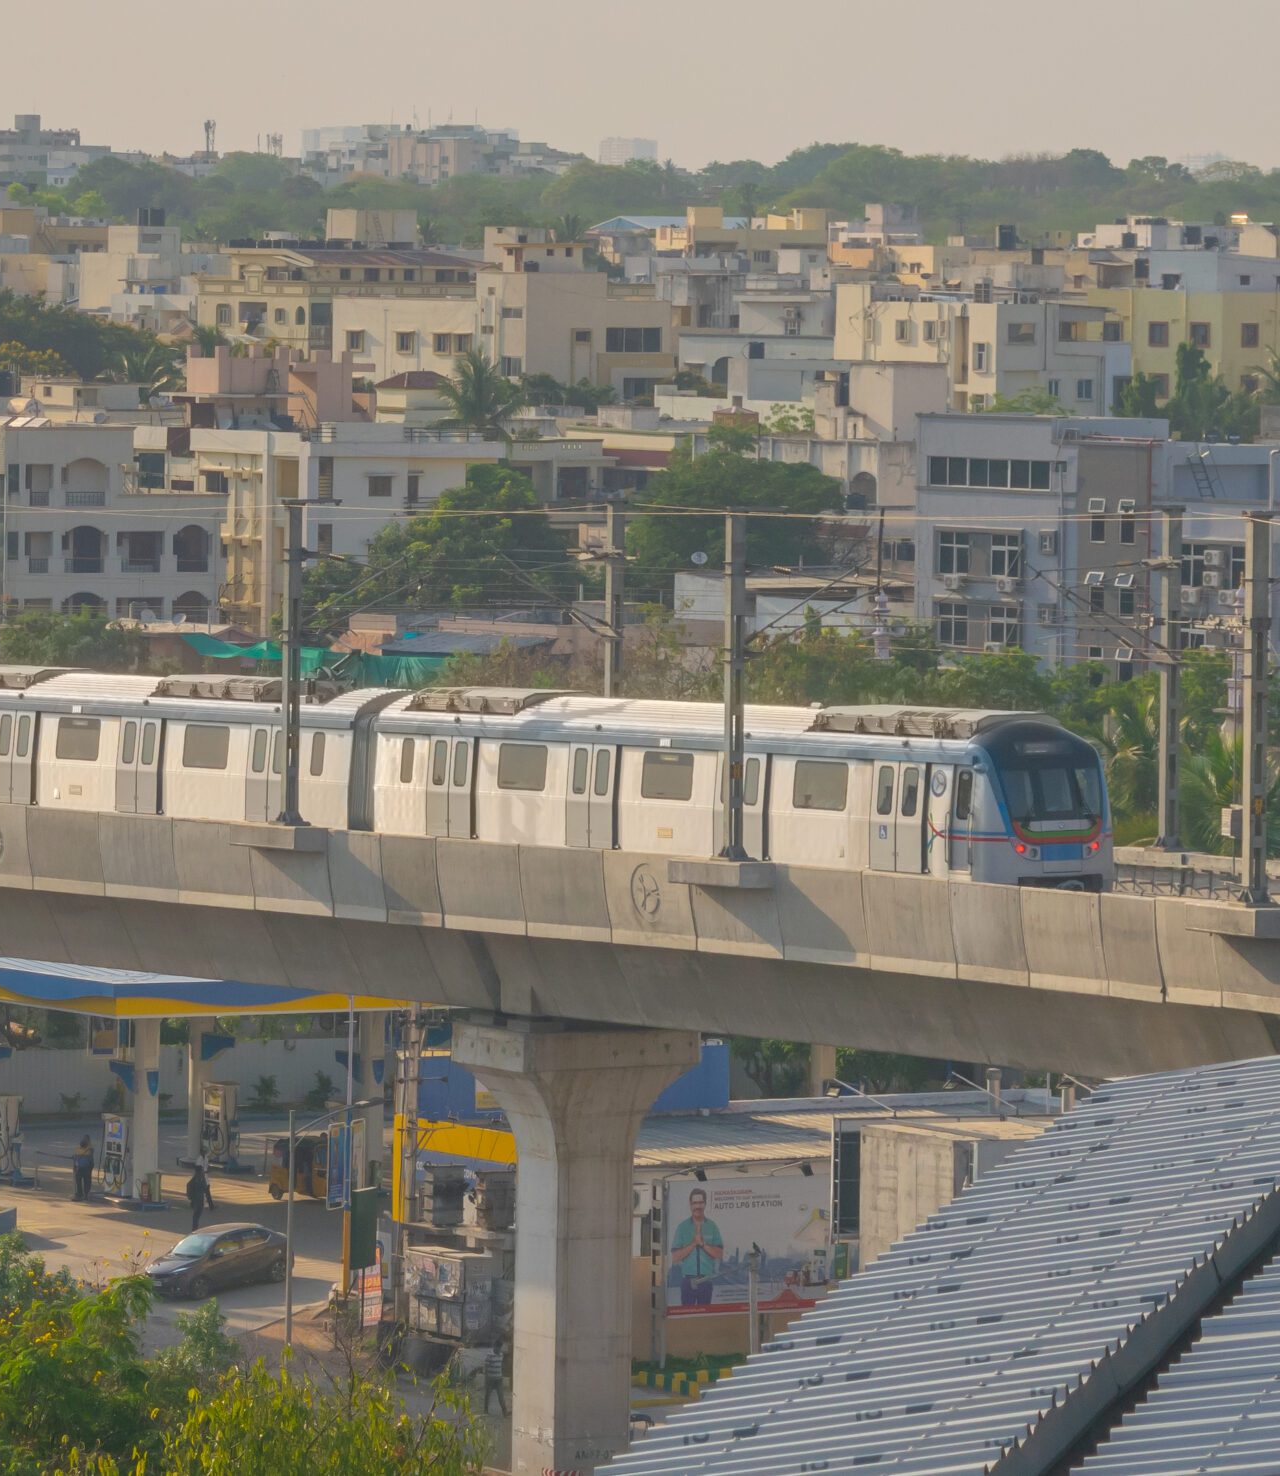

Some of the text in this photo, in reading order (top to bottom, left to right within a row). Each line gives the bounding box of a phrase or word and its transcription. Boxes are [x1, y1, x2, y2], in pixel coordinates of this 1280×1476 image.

[714, 1200, 783, 1210] AUTO LPG STATION
